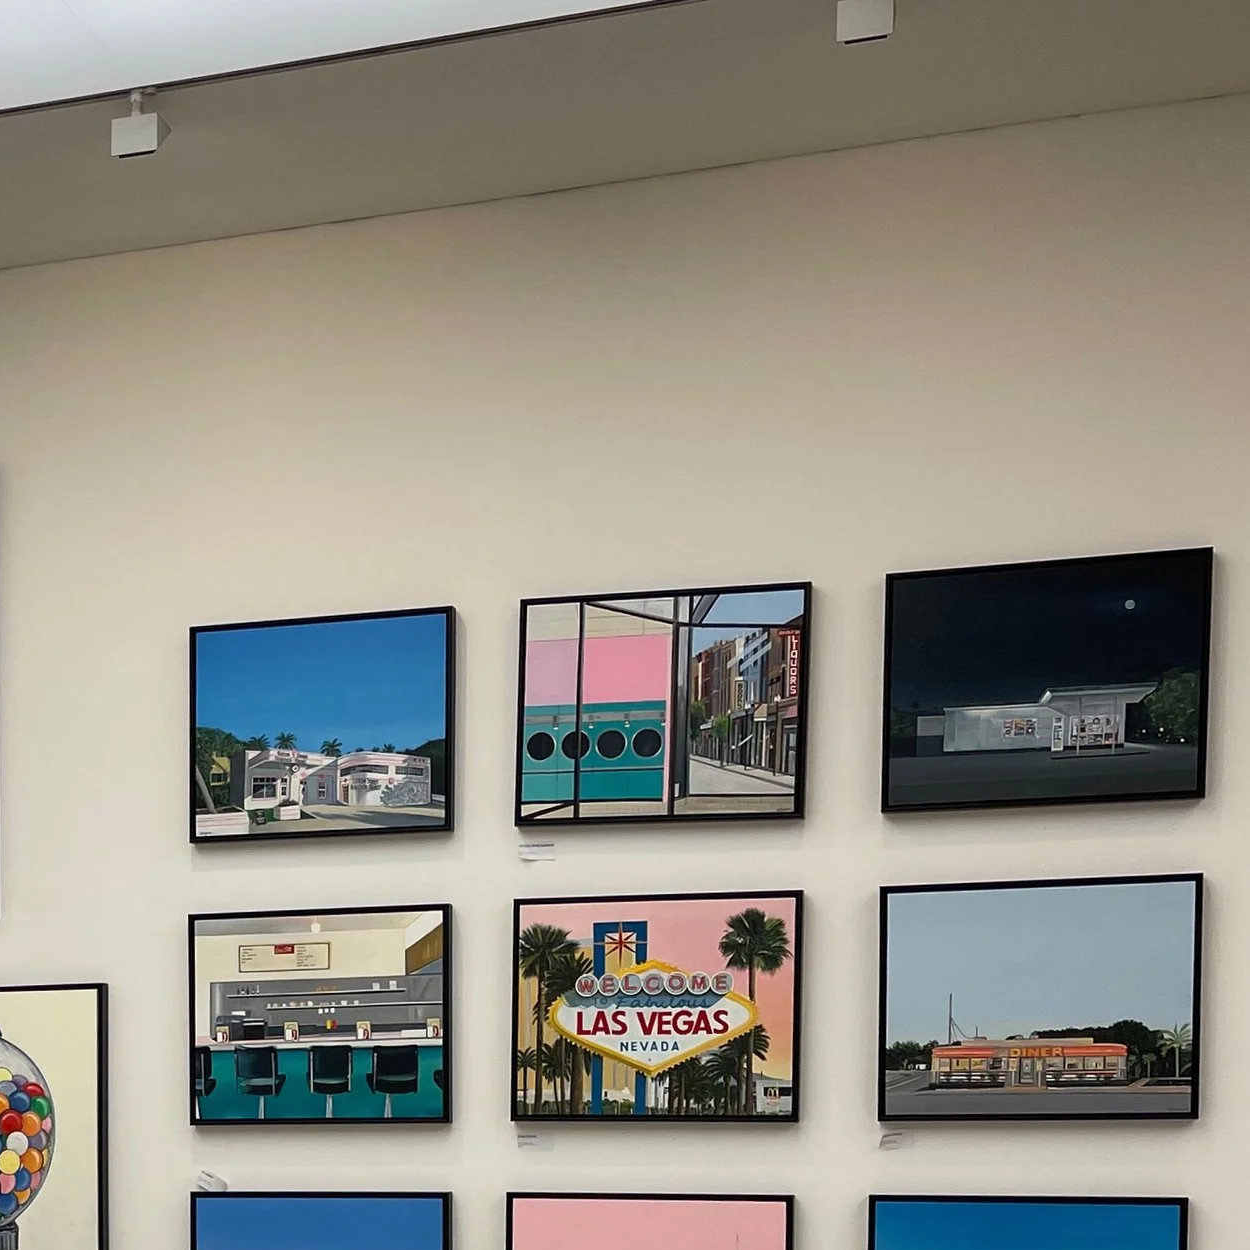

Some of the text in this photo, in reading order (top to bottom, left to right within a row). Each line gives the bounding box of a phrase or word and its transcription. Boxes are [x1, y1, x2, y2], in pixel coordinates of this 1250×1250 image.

[790, 635, 799, 695] LIQUORS
[578, 974, 729, 993] WELCOME
[576, 1010, 729, 1035] LAS VEGAS
[620, 1041, 680, 1051] NEVADA
[1010, 1047, 1063, 1057] DINER
